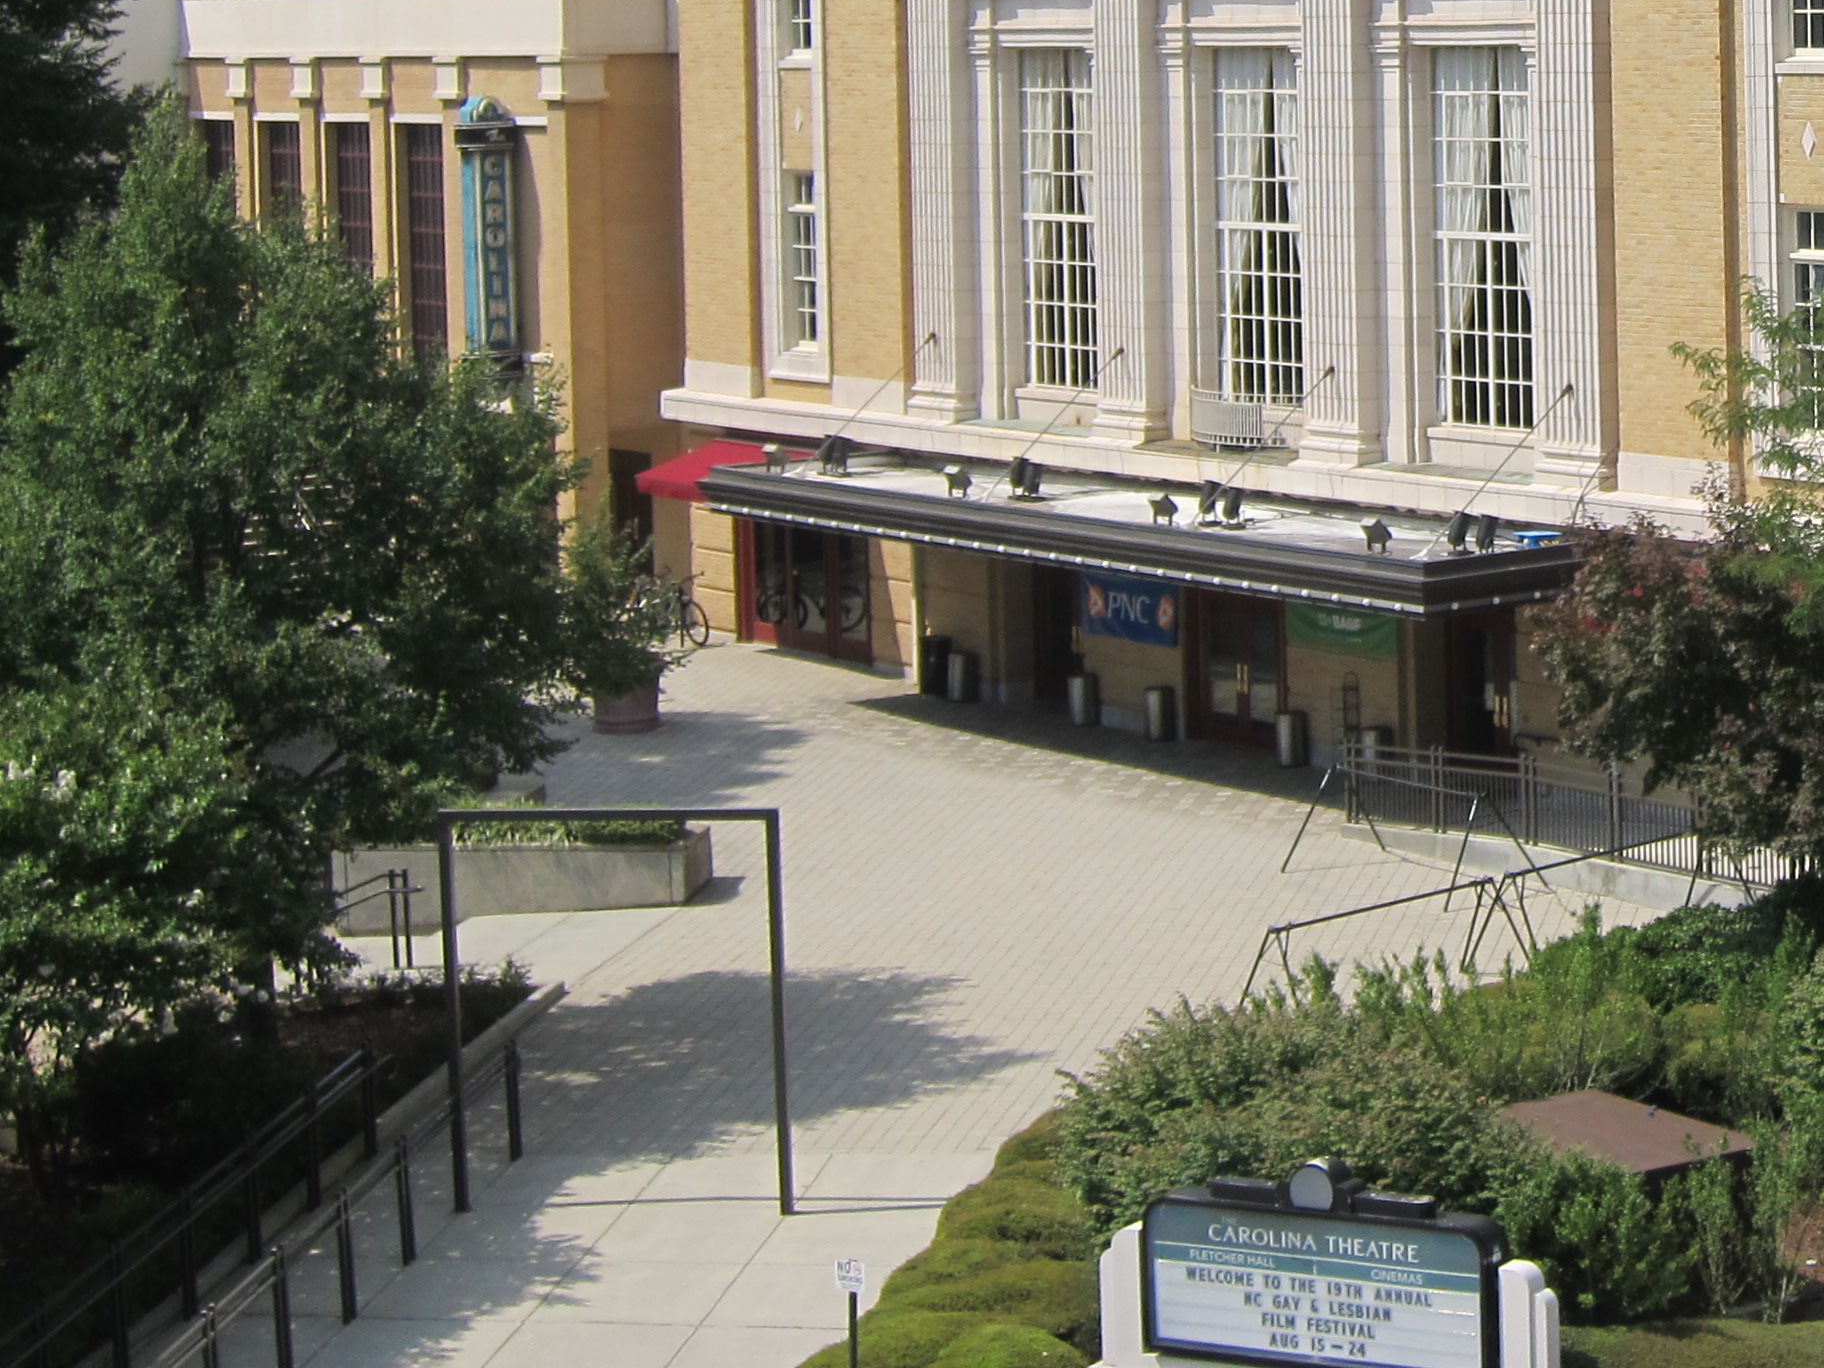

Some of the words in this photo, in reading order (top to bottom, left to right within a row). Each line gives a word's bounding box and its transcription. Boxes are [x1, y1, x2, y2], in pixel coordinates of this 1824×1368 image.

[483, 154, 508, 342] CAROLINA
[1107, 591, 1150, 624] PNC
[1208, 1224, 1317, 1251] CAROLINA
[1325, 1235, 1420, 1263] THEATRE
[837, 1261, 851, 1274] NO
[1190, 1248, 1244, 1264] FLETCHER
[1247, 1256, 1276, 1268] HALL
[1185, 1265, 1254, 1287] WELCOME
[1262, 1274, 1281, 1289] TO
[1289, 1277, 1316, 1294] THE
[1327, 1281, 1362, 1299] 19TH
[1374, 1287, 1433, 1307] ANNUAL
[1370, 1269, 1423, 1285] CINEMAS
[1243, 1293, 1262, 1307] NC
[1272, 1294, 1301, 1310] GAY
[1310, 1299, 1319, 1313] &
[1329, 1302, 1392, 1322] LESBIAN
[1261, 1312, 1296, 1329] FILM
[1307, 1318, 1375, 1340] FESTIVAL
[1269, 1333, 1299, 1349] AUG
[1311, 1337, 1325, 1352] 15
[1348, 1342, 1366, 1357] 24
